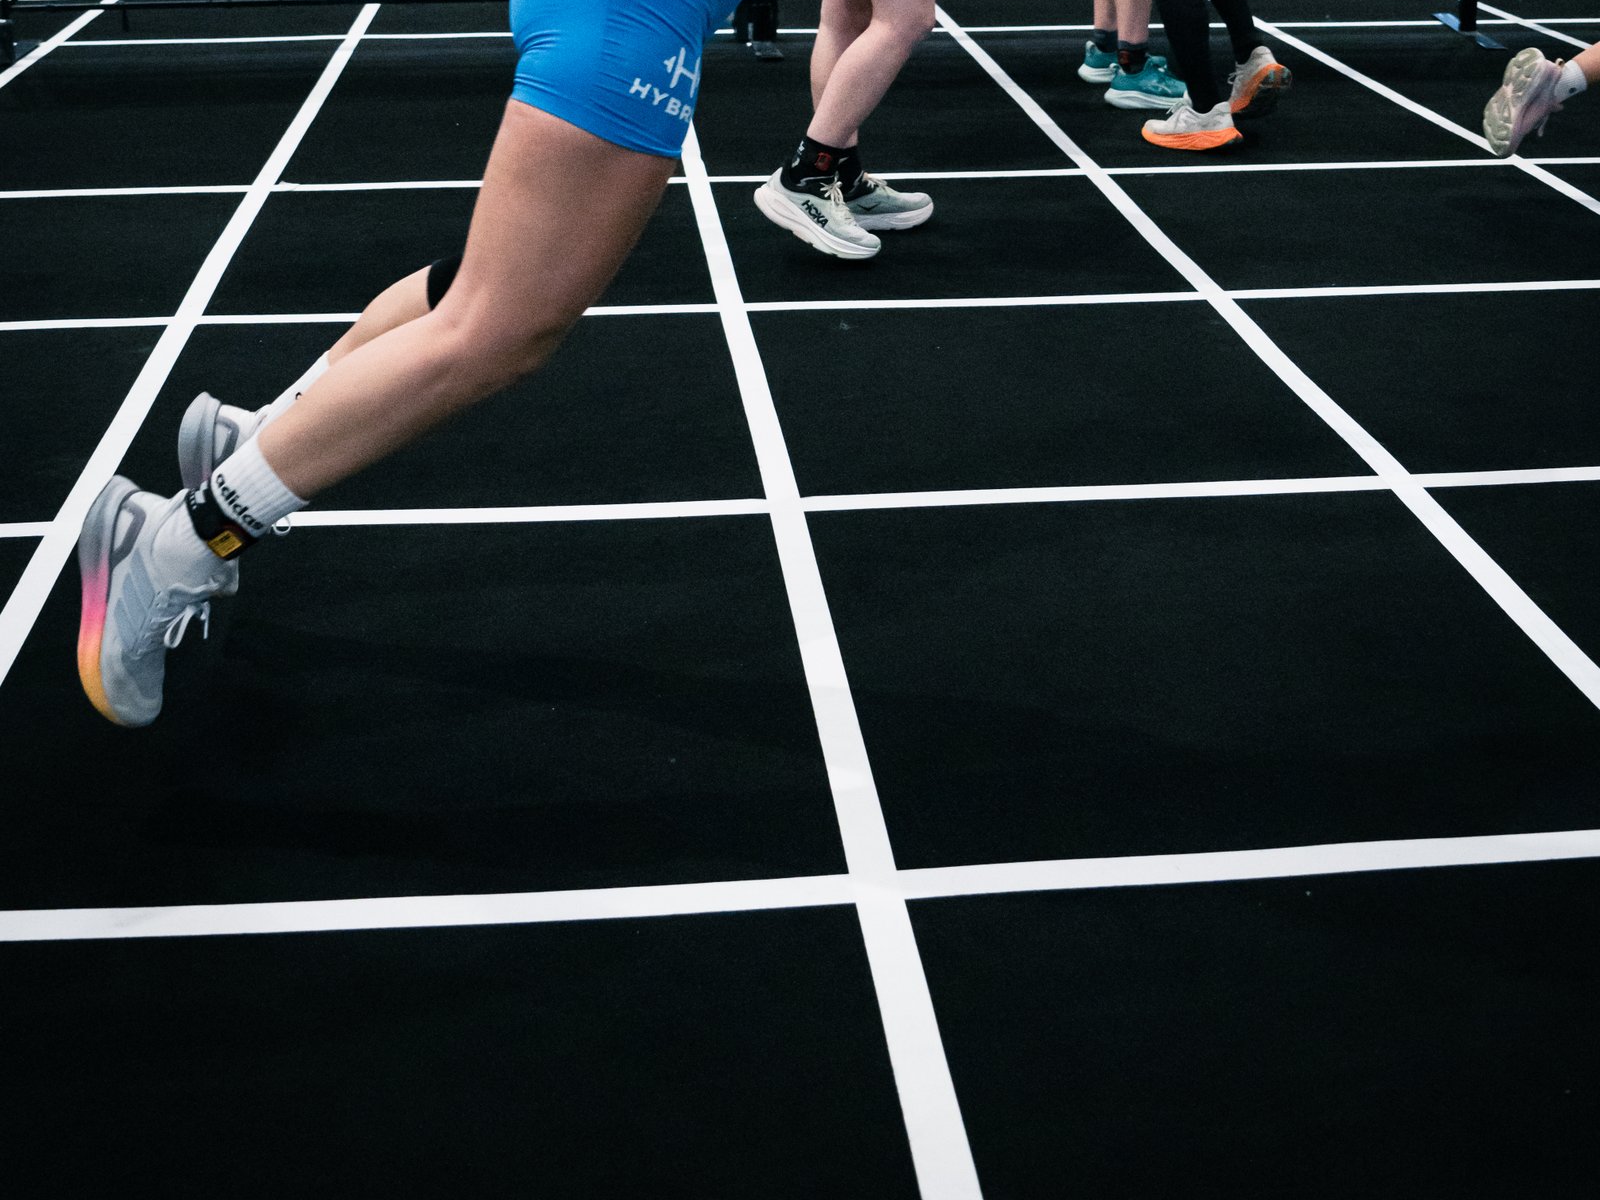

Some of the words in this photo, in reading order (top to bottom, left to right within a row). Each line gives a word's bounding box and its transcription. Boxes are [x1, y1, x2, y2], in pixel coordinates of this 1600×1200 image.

[629, 77, 693, 123] HYBR
[801, 199, 829, 228] HOKA
[216, 473, 264, 531] adidas
